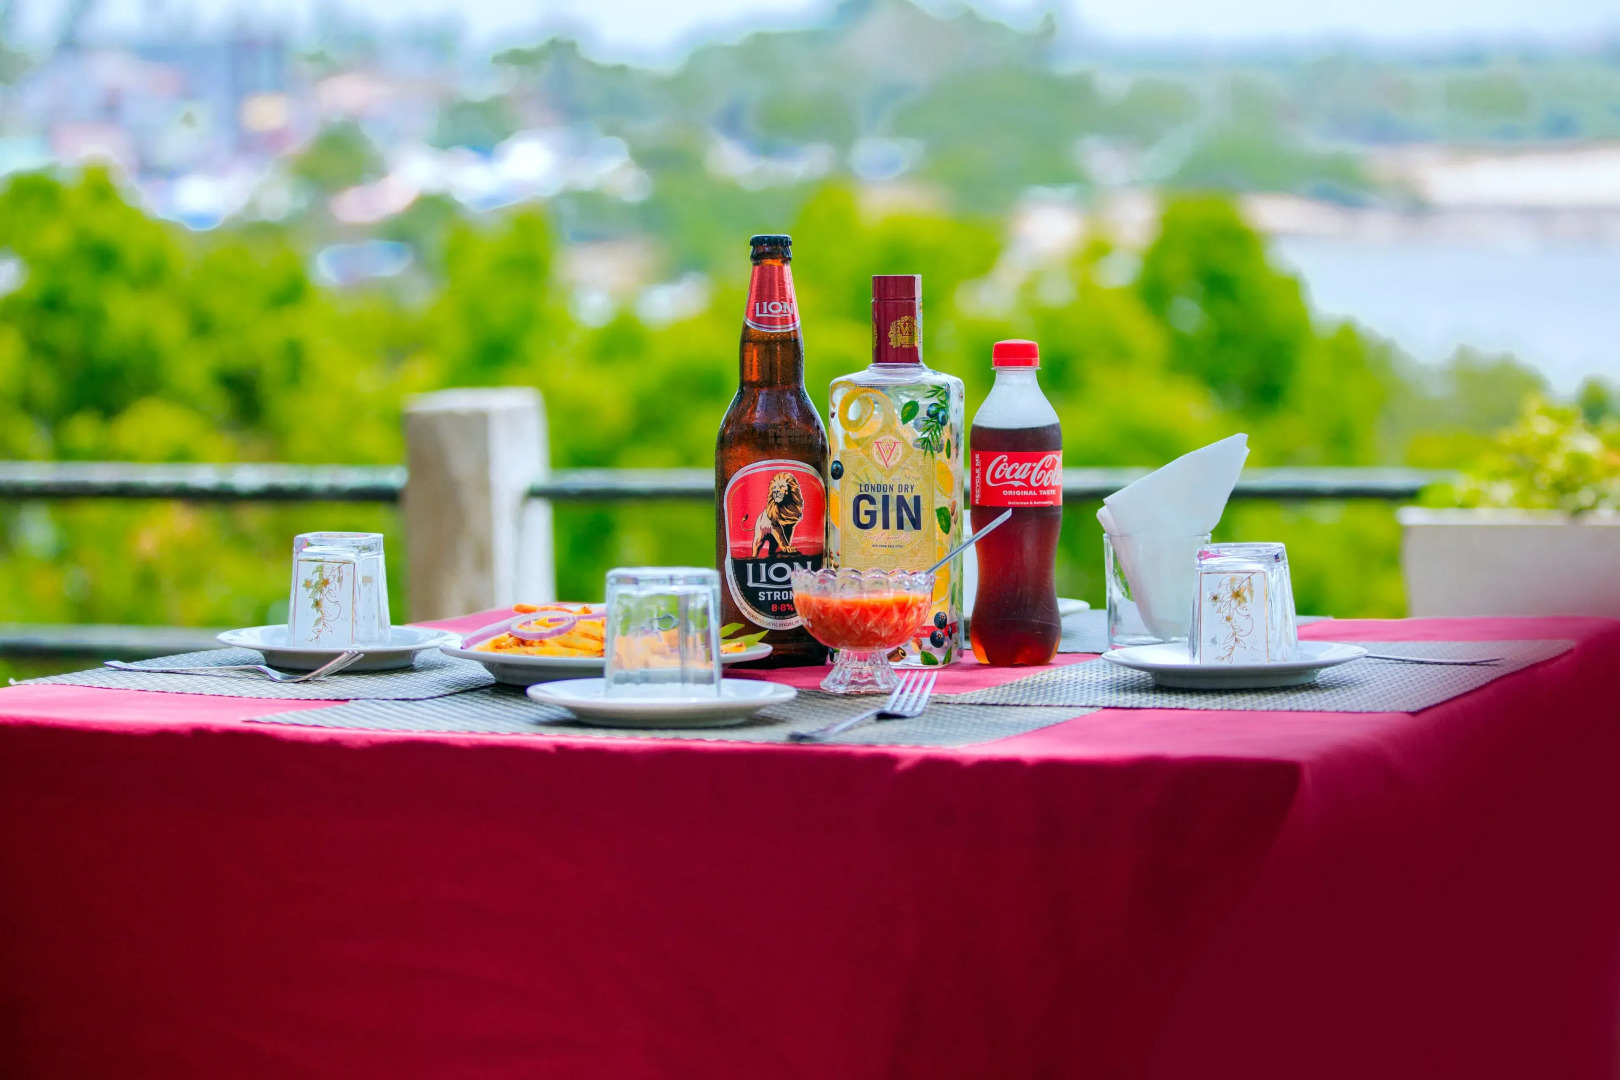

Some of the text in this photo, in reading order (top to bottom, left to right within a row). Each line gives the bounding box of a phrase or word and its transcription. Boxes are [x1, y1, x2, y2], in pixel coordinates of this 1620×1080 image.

[755, 301, 794, 317] LION
[975, 453, 981, 466] ME
[859, 483, 915, 493] LONDON DRY
[852, 493, 922, 531] GIN
